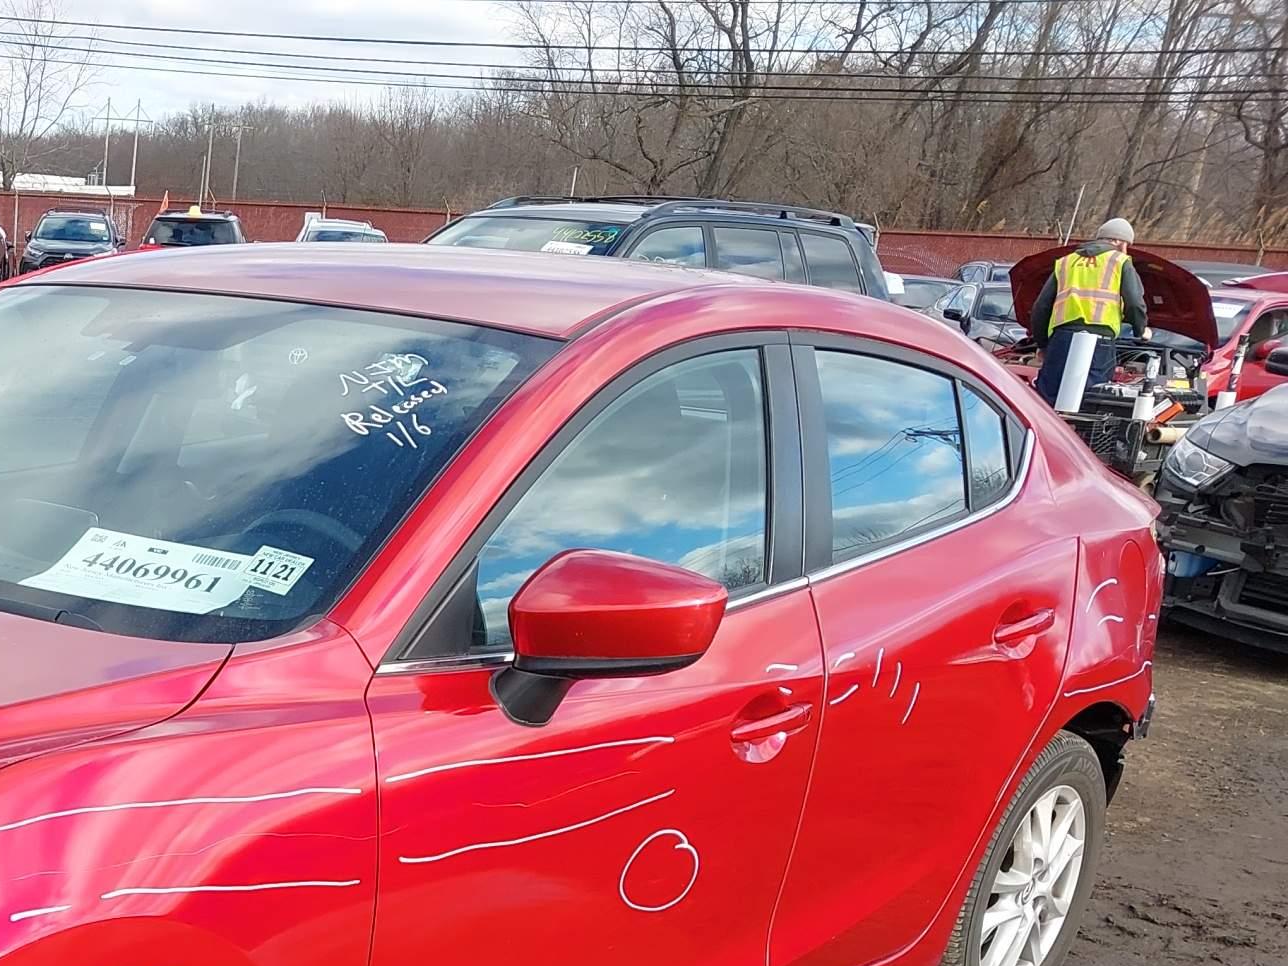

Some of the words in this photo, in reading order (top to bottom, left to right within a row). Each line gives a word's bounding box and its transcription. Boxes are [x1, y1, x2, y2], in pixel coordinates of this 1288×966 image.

[340, 380, 448, 435] Released
[386, 413, 432, 449] 1/6
[81, 551, 222, 593] 44069961
[250, 558, 275, 576] 11
[271, 564, 297, 581] 21
